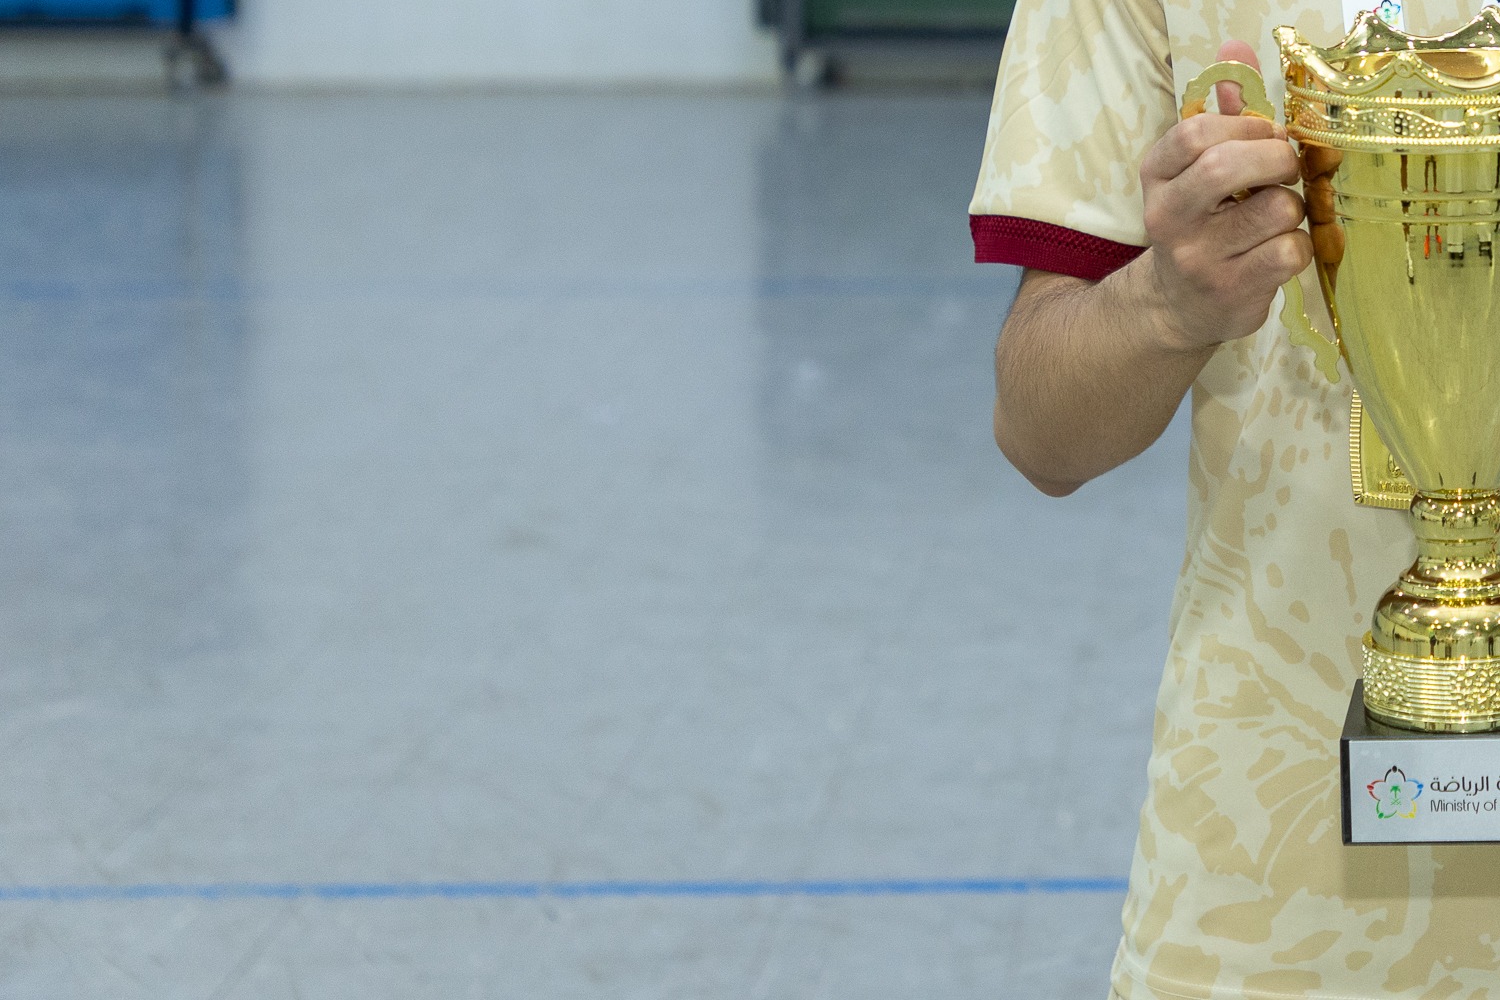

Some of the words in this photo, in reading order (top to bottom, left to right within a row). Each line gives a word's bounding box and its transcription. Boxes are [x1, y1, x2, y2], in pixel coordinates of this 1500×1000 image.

[1430, 775, 1489, 797] الرياضة
[1430, 799, 1480, 814] Ministry
[1483, 798, 1498, 812] of
